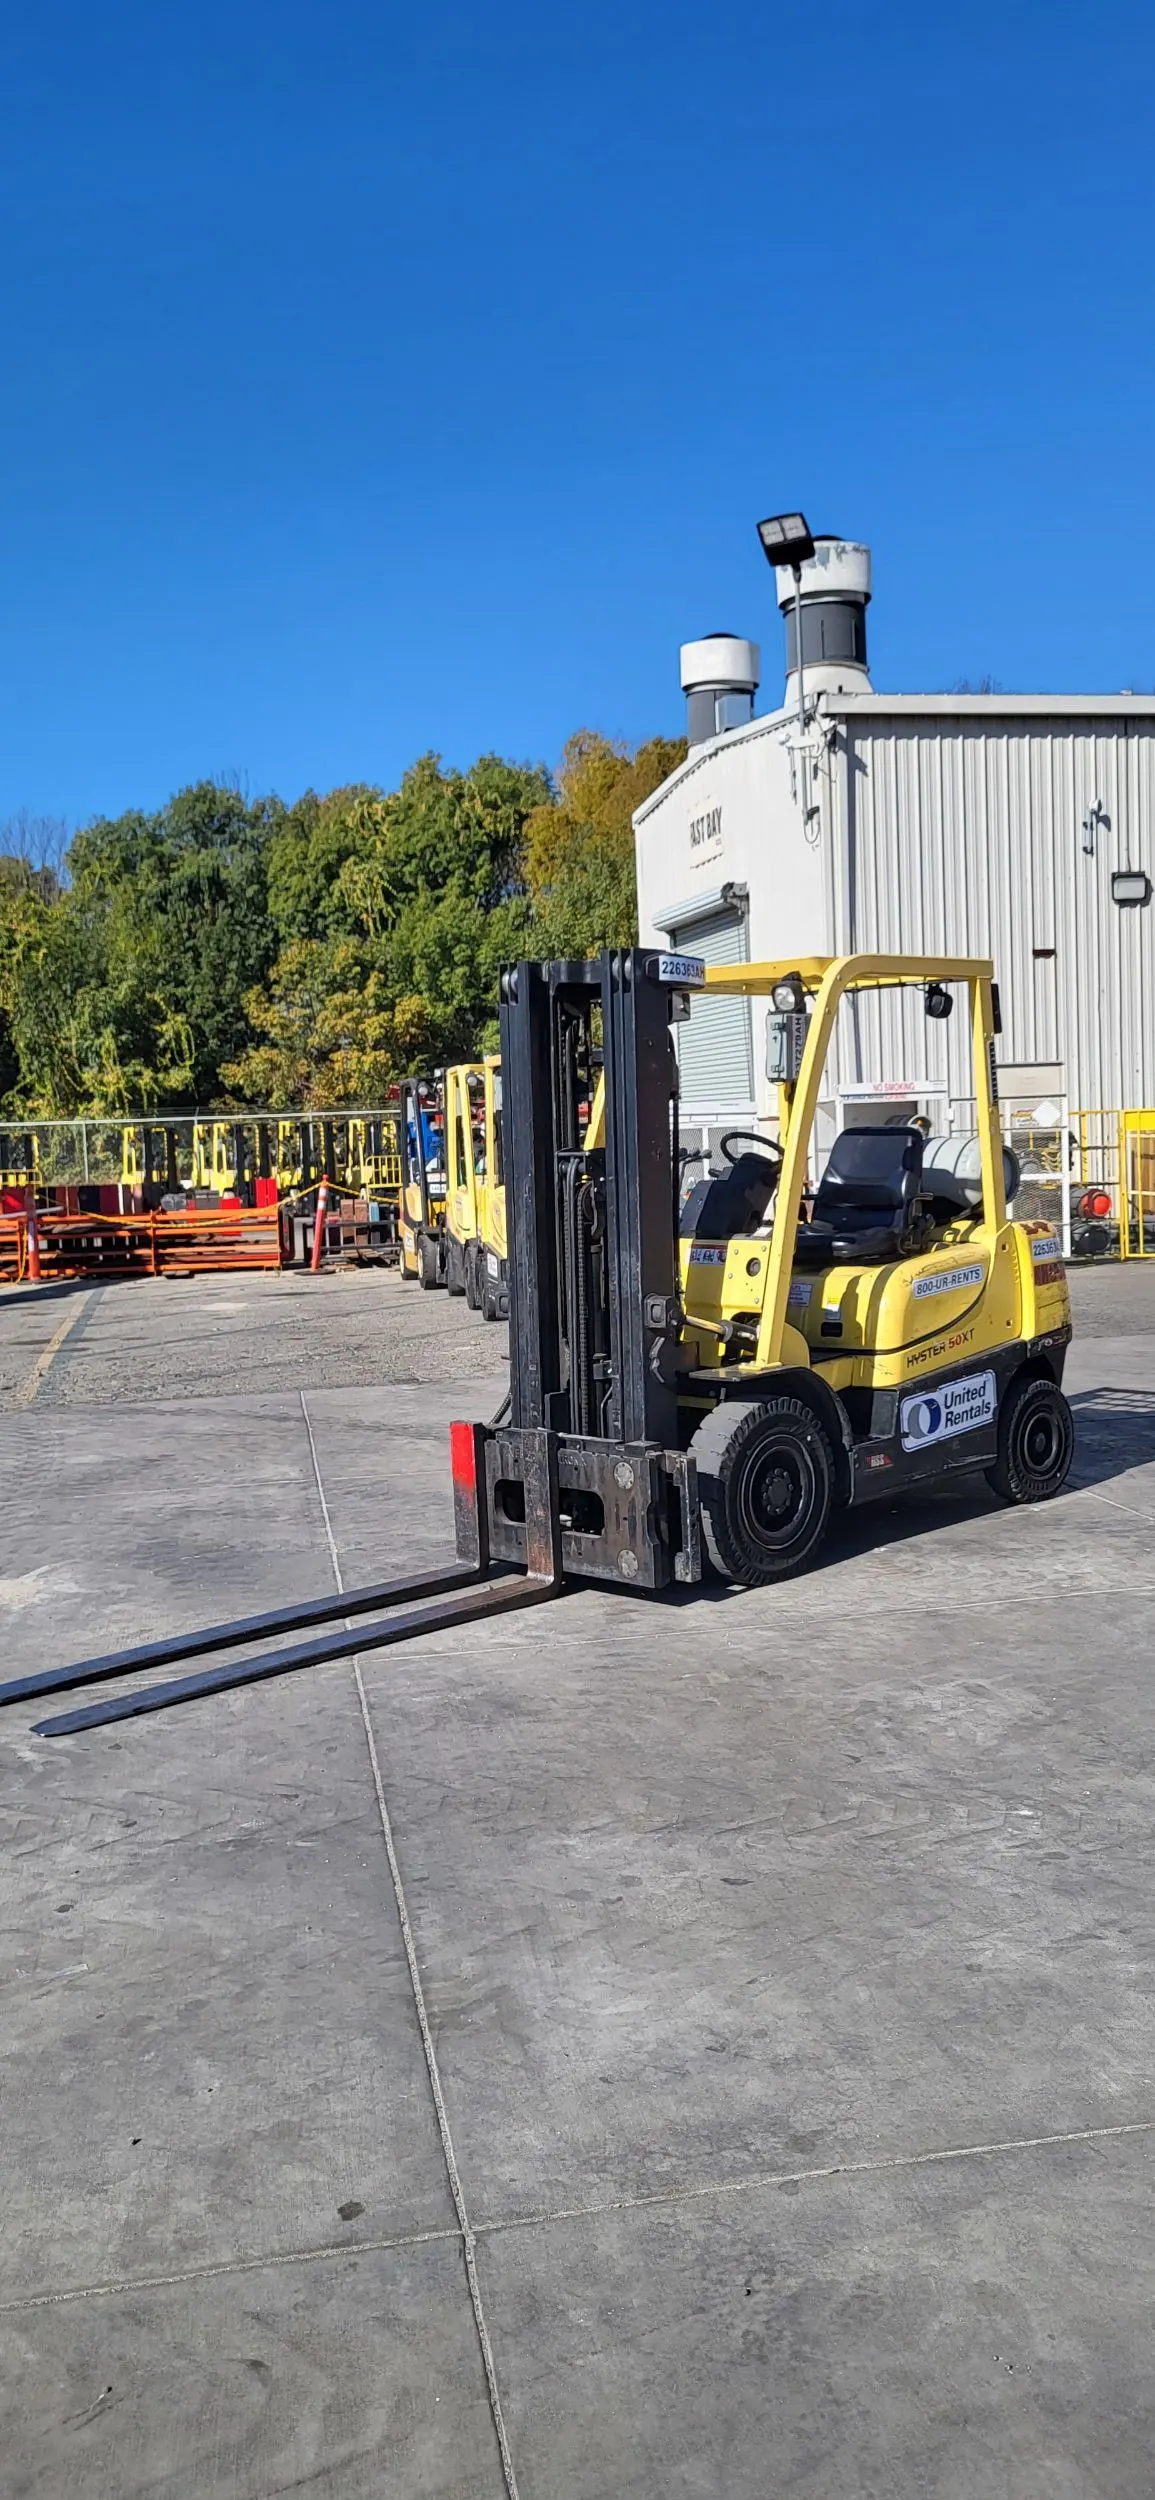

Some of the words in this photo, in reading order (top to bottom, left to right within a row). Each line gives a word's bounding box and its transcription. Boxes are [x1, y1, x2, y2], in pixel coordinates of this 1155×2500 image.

[706, 805, 722, 840] BAY
[873, 1083, 883, 1092] NO
[884, 1082, 915, 1092] SMOKING
[916, 1268, 981, 1295] 800-UR-RENTS
[906, 1342, 947, 1369] HYSTER
[948, 1327, 976, 1350] 50XT
[944, 1380, 987, 1410] United
[944, 1399, 992, 1429] Rentals
